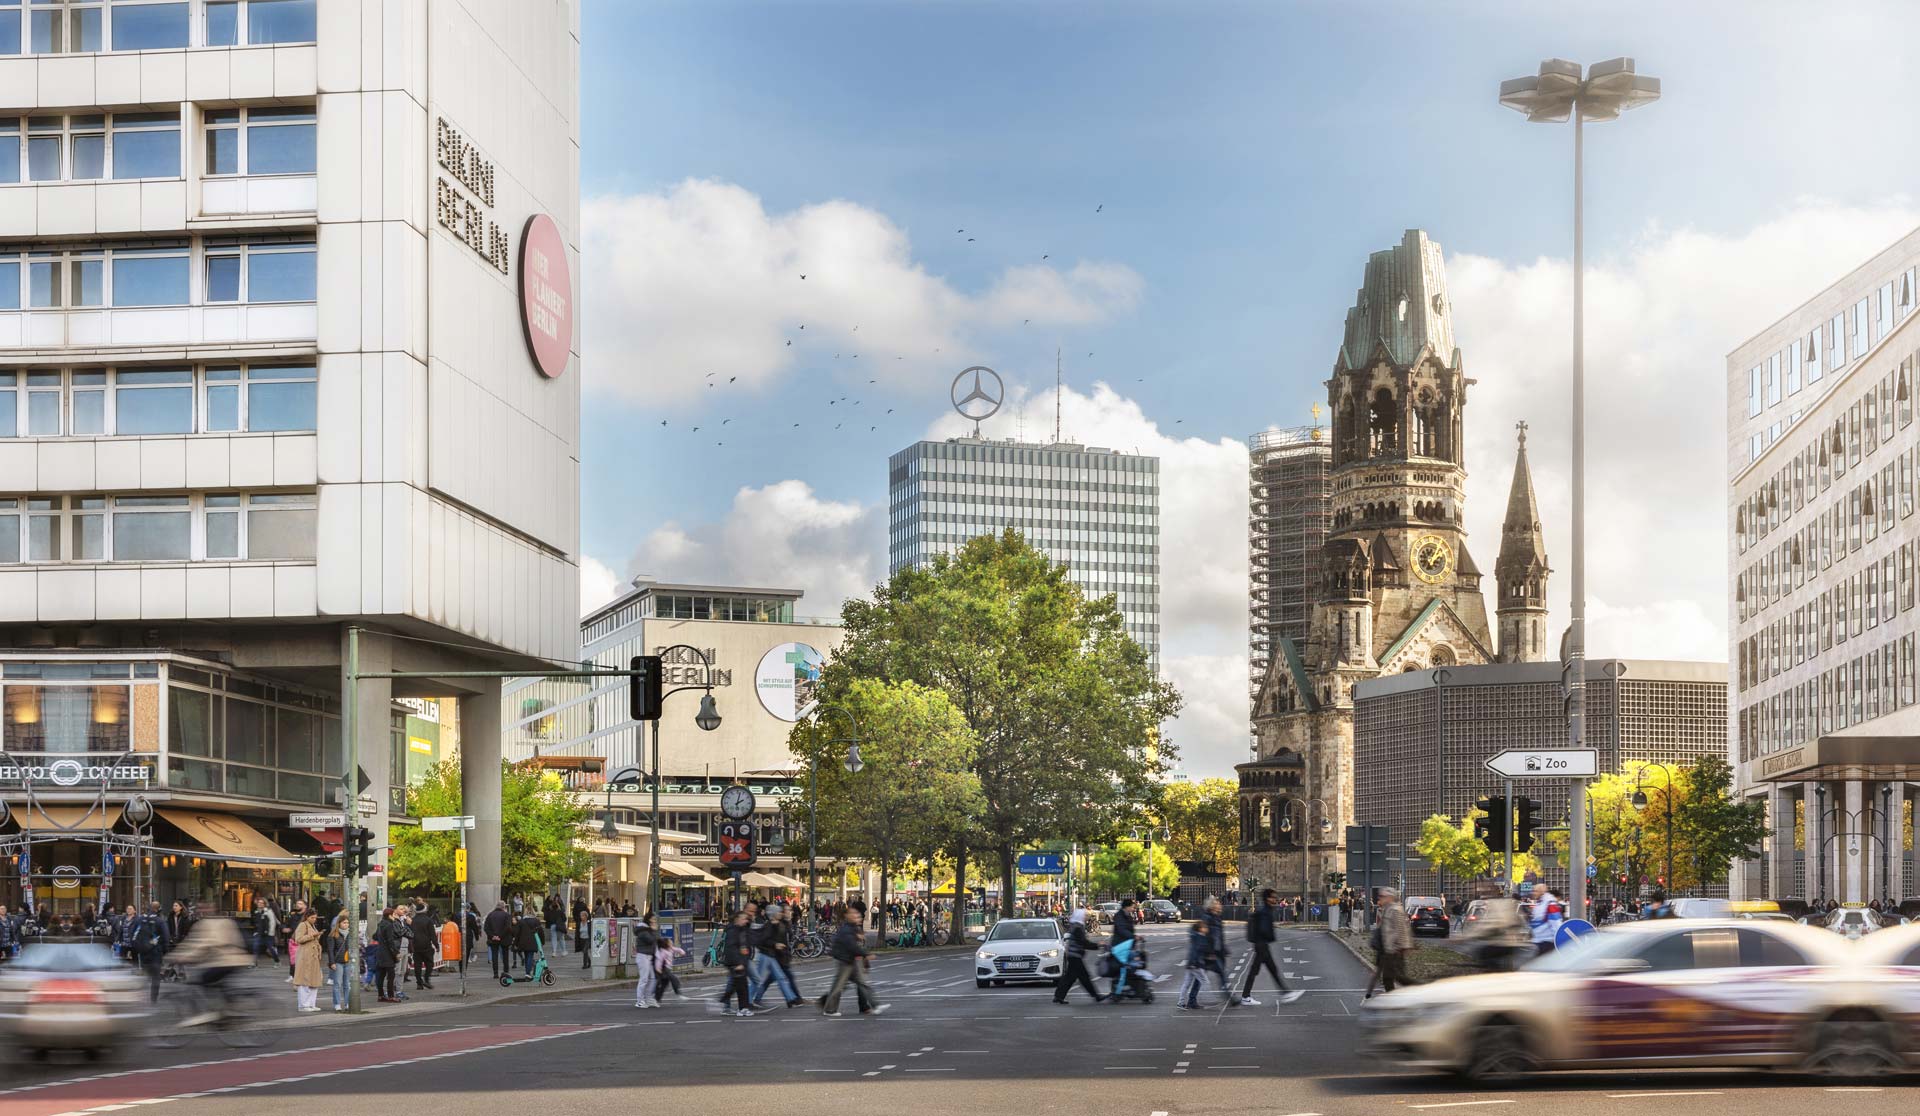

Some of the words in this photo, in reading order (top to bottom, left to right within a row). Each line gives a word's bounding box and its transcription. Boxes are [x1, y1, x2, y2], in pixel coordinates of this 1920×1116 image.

[438, 116, 494, 208] BIKINI
[438, 176, 508, 275] BERLIN
[532, 302, 558, 341] BERLIN
[656, 646, 716, 665] BIKINI
[661, 666, 732, 686] BERLIN
[1545, 758, 1568, 769] Zoo
[603, 784, 723, 794] ROOFTO
[682, 846, 719, 855] SCHNABU
[729, 843, 743, 854] 36
[459, 852, 464, 862] U
[1037, 856, 1045, 866] U
